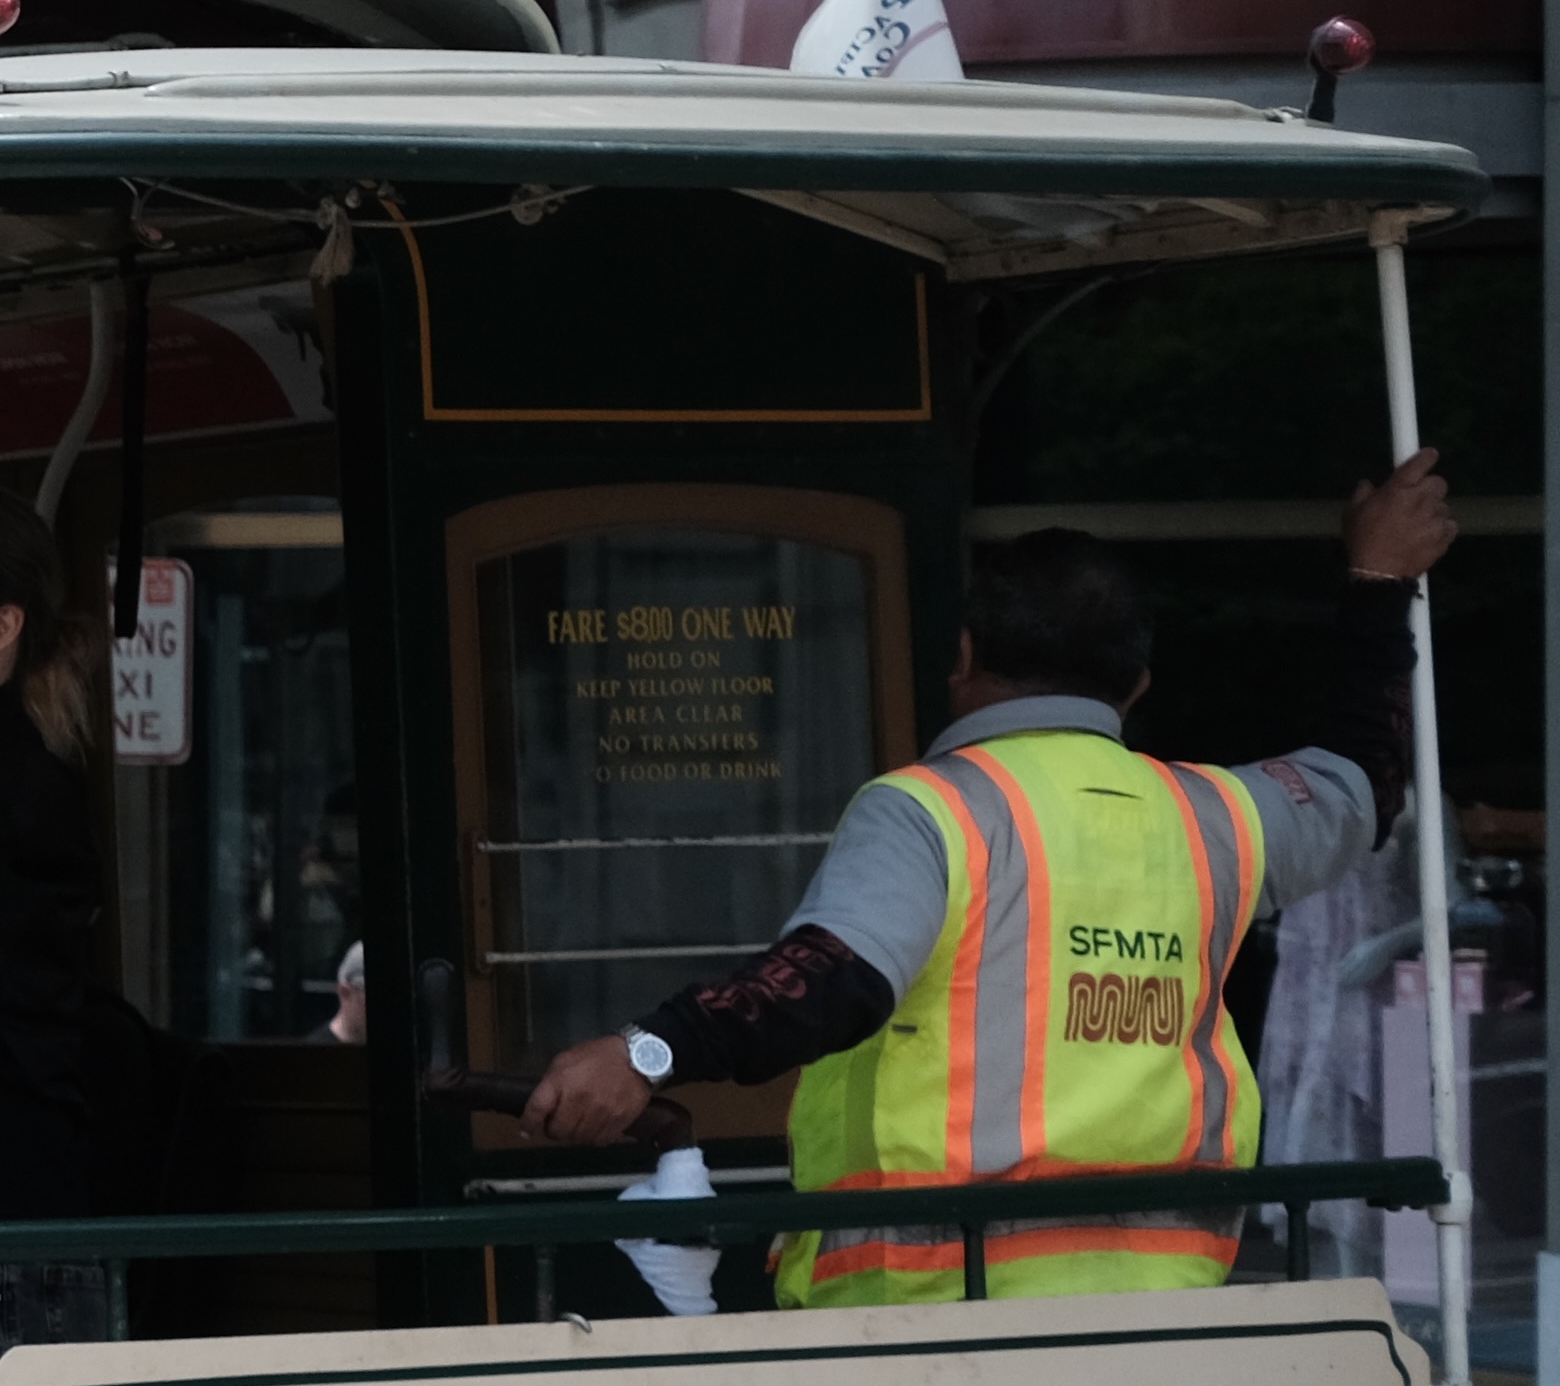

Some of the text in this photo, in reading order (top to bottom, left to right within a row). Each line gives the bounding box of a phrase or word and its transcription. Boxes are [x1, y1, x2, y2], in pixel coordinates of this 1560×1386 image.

[547, 608, 608, 645] FARE
[681, 605, 734, 642] ONE
[742, 604, 796, 641] WAY
[626, 650, 721, 670] HOLD ON
[575, 679, 622, 699] KEEP
[628, 677, 705, 697] YELLOW
[609, 704, 744, 726] AREA CLEAR
[599, 735, 630, 754] NO
[683, 761, 712, 781] OR
[719, 759, 783, 779] DRINK
[1069, 925, 1183, 963] SFMTA
